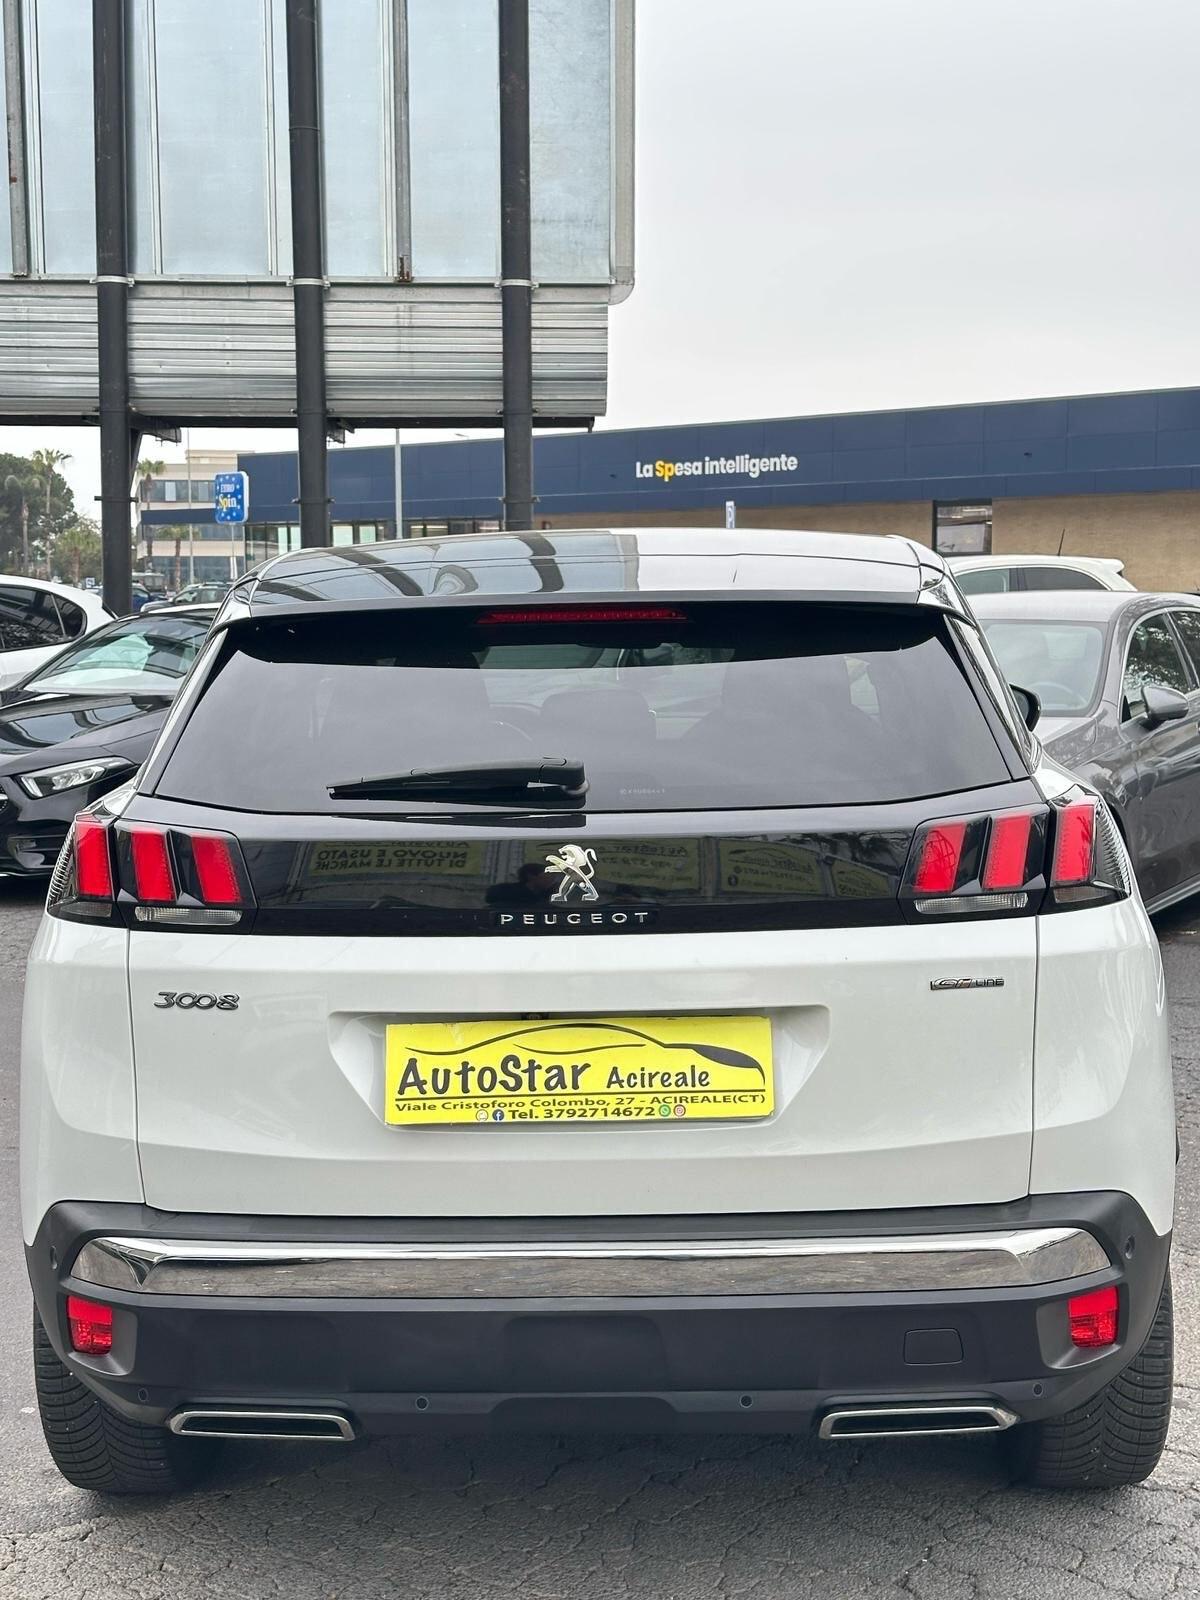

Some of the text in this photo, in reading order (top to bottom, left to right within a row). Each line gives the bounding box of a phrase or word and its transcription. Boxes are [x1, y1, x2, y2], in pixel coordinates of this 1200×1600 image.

[636, 454, 799, 482] La Spesa intelligente
[500, 912, 649, 925] PEUGEOT
[153, 991, 240, 1010] 3008
[397, 1054, 710, 1096] AutoStar Acireale
[395, 1102, 437, 1112] Viale
[441, 1100, 526, 1111] Cristoforo
[530, 1097, 610, 1108] Colombo,
[615, 1097, 633, 1105] 27
[650, 1093, 766, 1105] ACIREALE(CT)
[508, 1109, 539, 1119] Tel.
[543, 1106, 656, 1119] 3792714672
